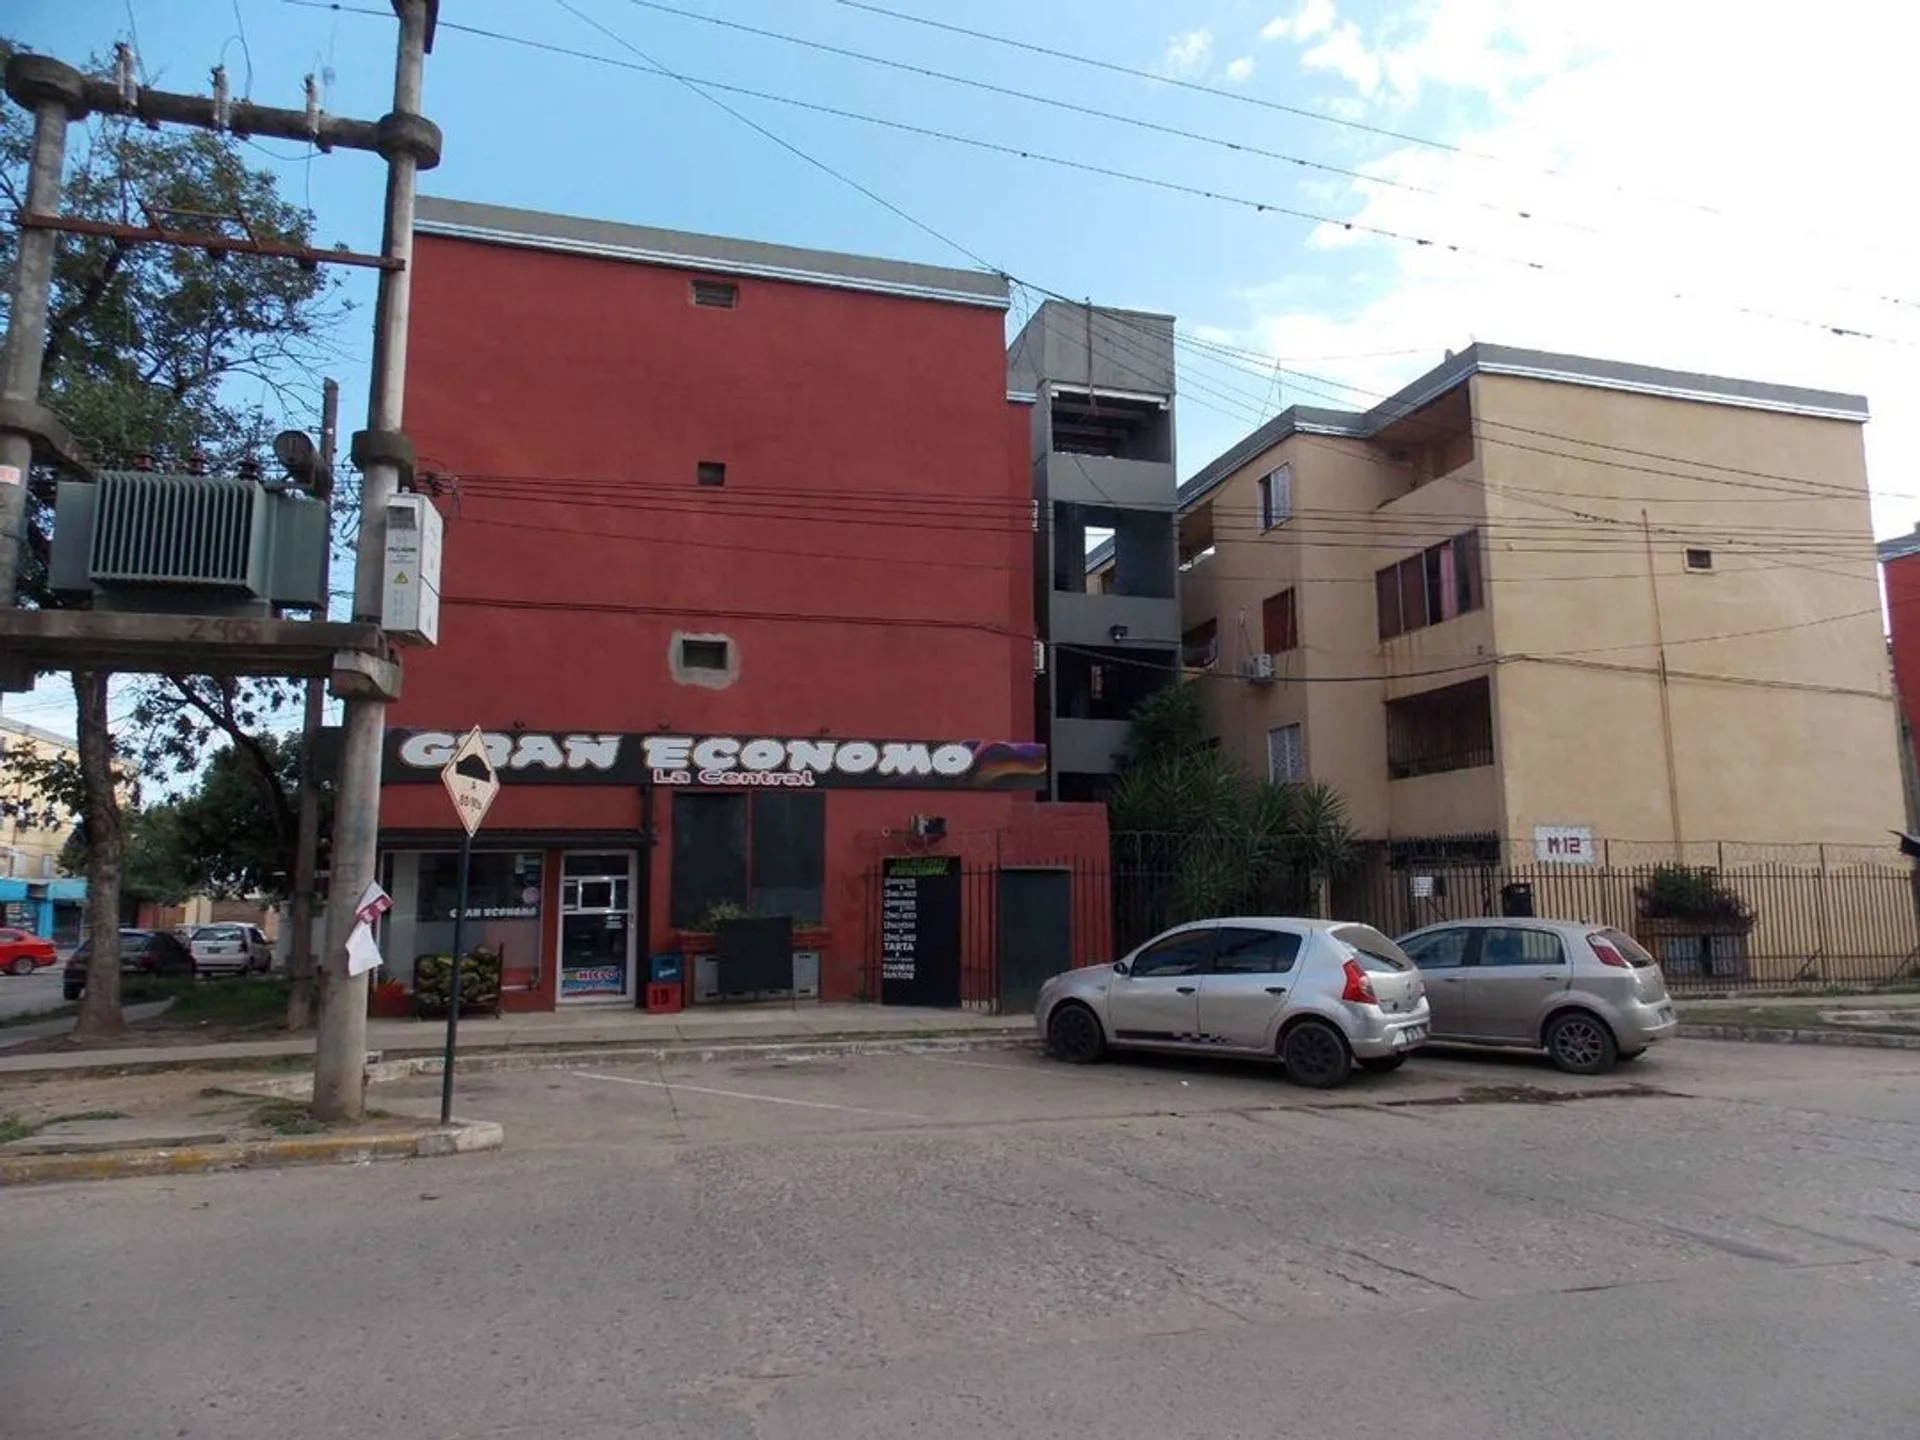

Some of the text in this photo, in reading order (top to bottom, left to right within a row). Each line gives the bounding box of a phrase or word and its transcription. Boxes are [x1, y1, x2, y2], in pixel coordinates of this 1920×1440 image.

[643, 737, 974, 775] ECONOMO
[653, 768, 816, 787] La Central
[883, 942, 915, 951] TARTA
